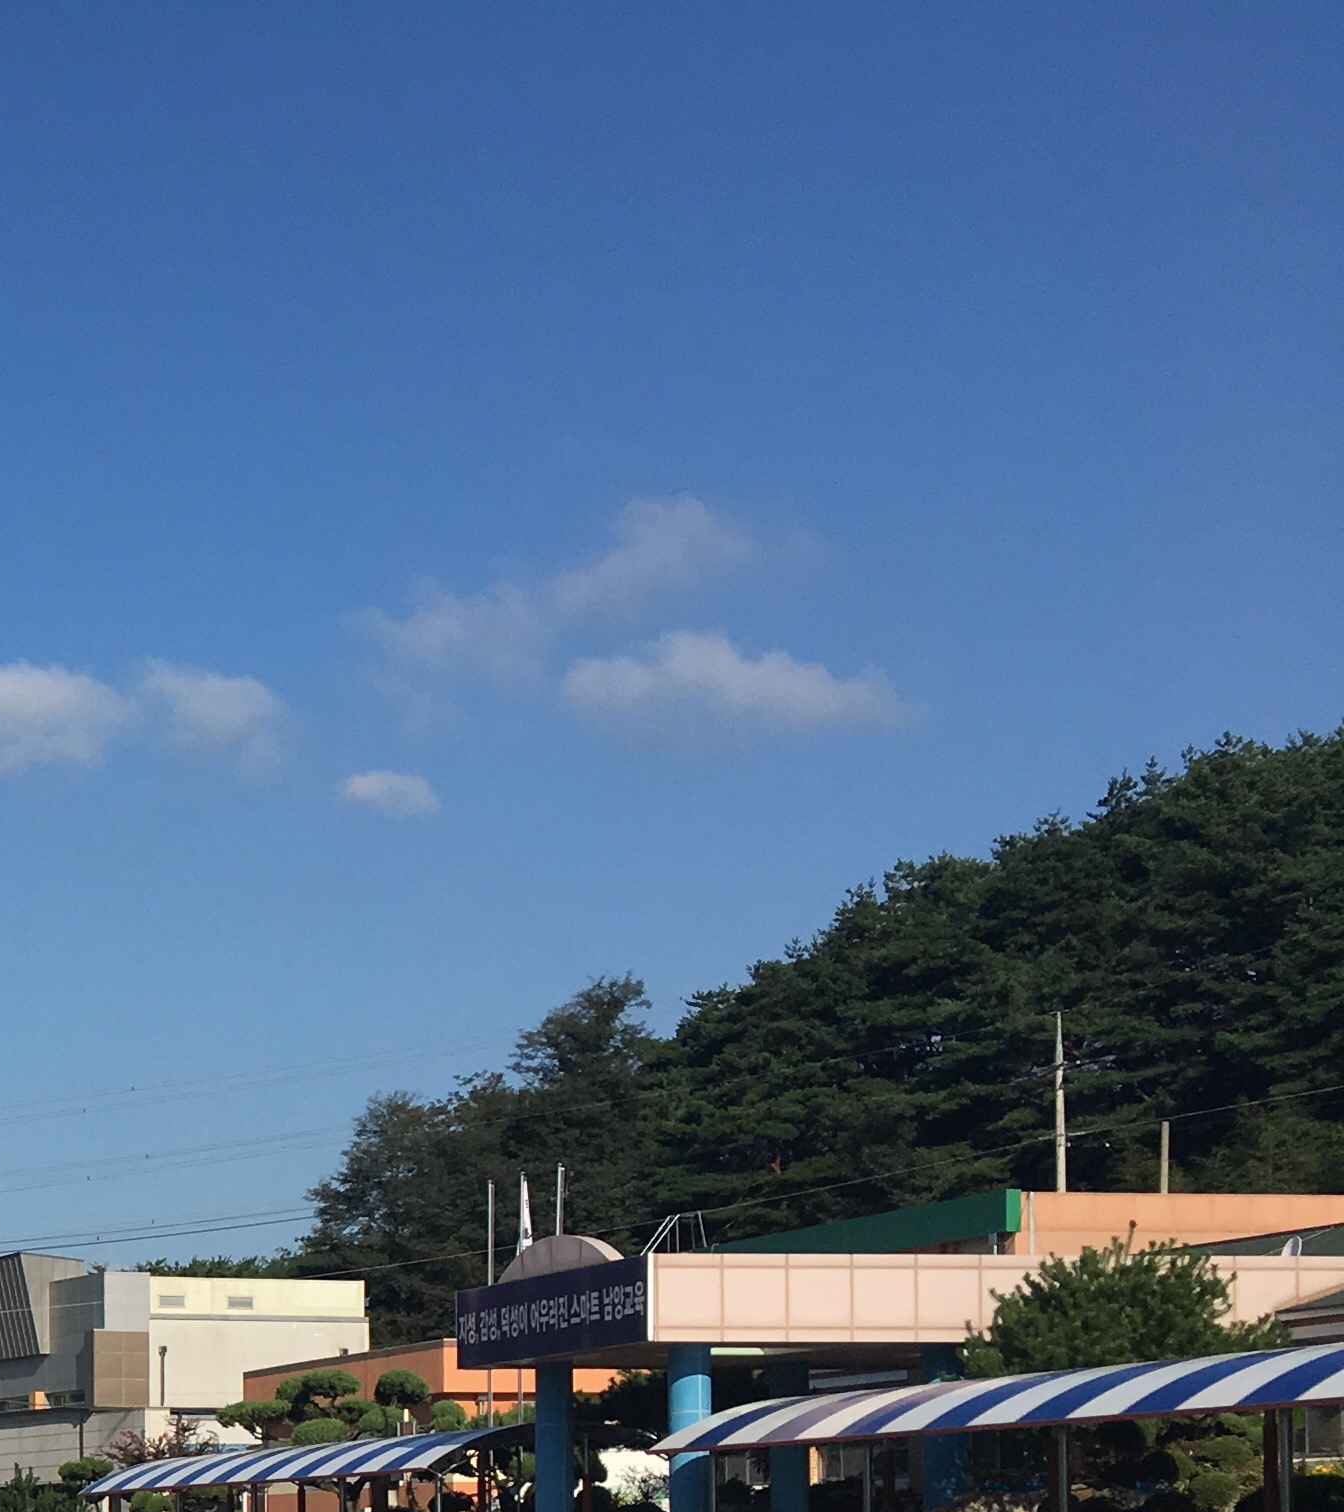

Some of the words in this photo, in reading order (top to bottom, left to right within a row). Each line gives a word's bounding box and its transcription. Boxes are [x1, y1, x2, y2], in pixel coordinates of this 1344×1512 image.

[501, 1302, 528, 1337] 덕성이
[530, 1295, 568, 1334] 어우러진
[570, 1290, 600, 1324] 스마트
[603, 1281, 645, 1321] 남양교육
